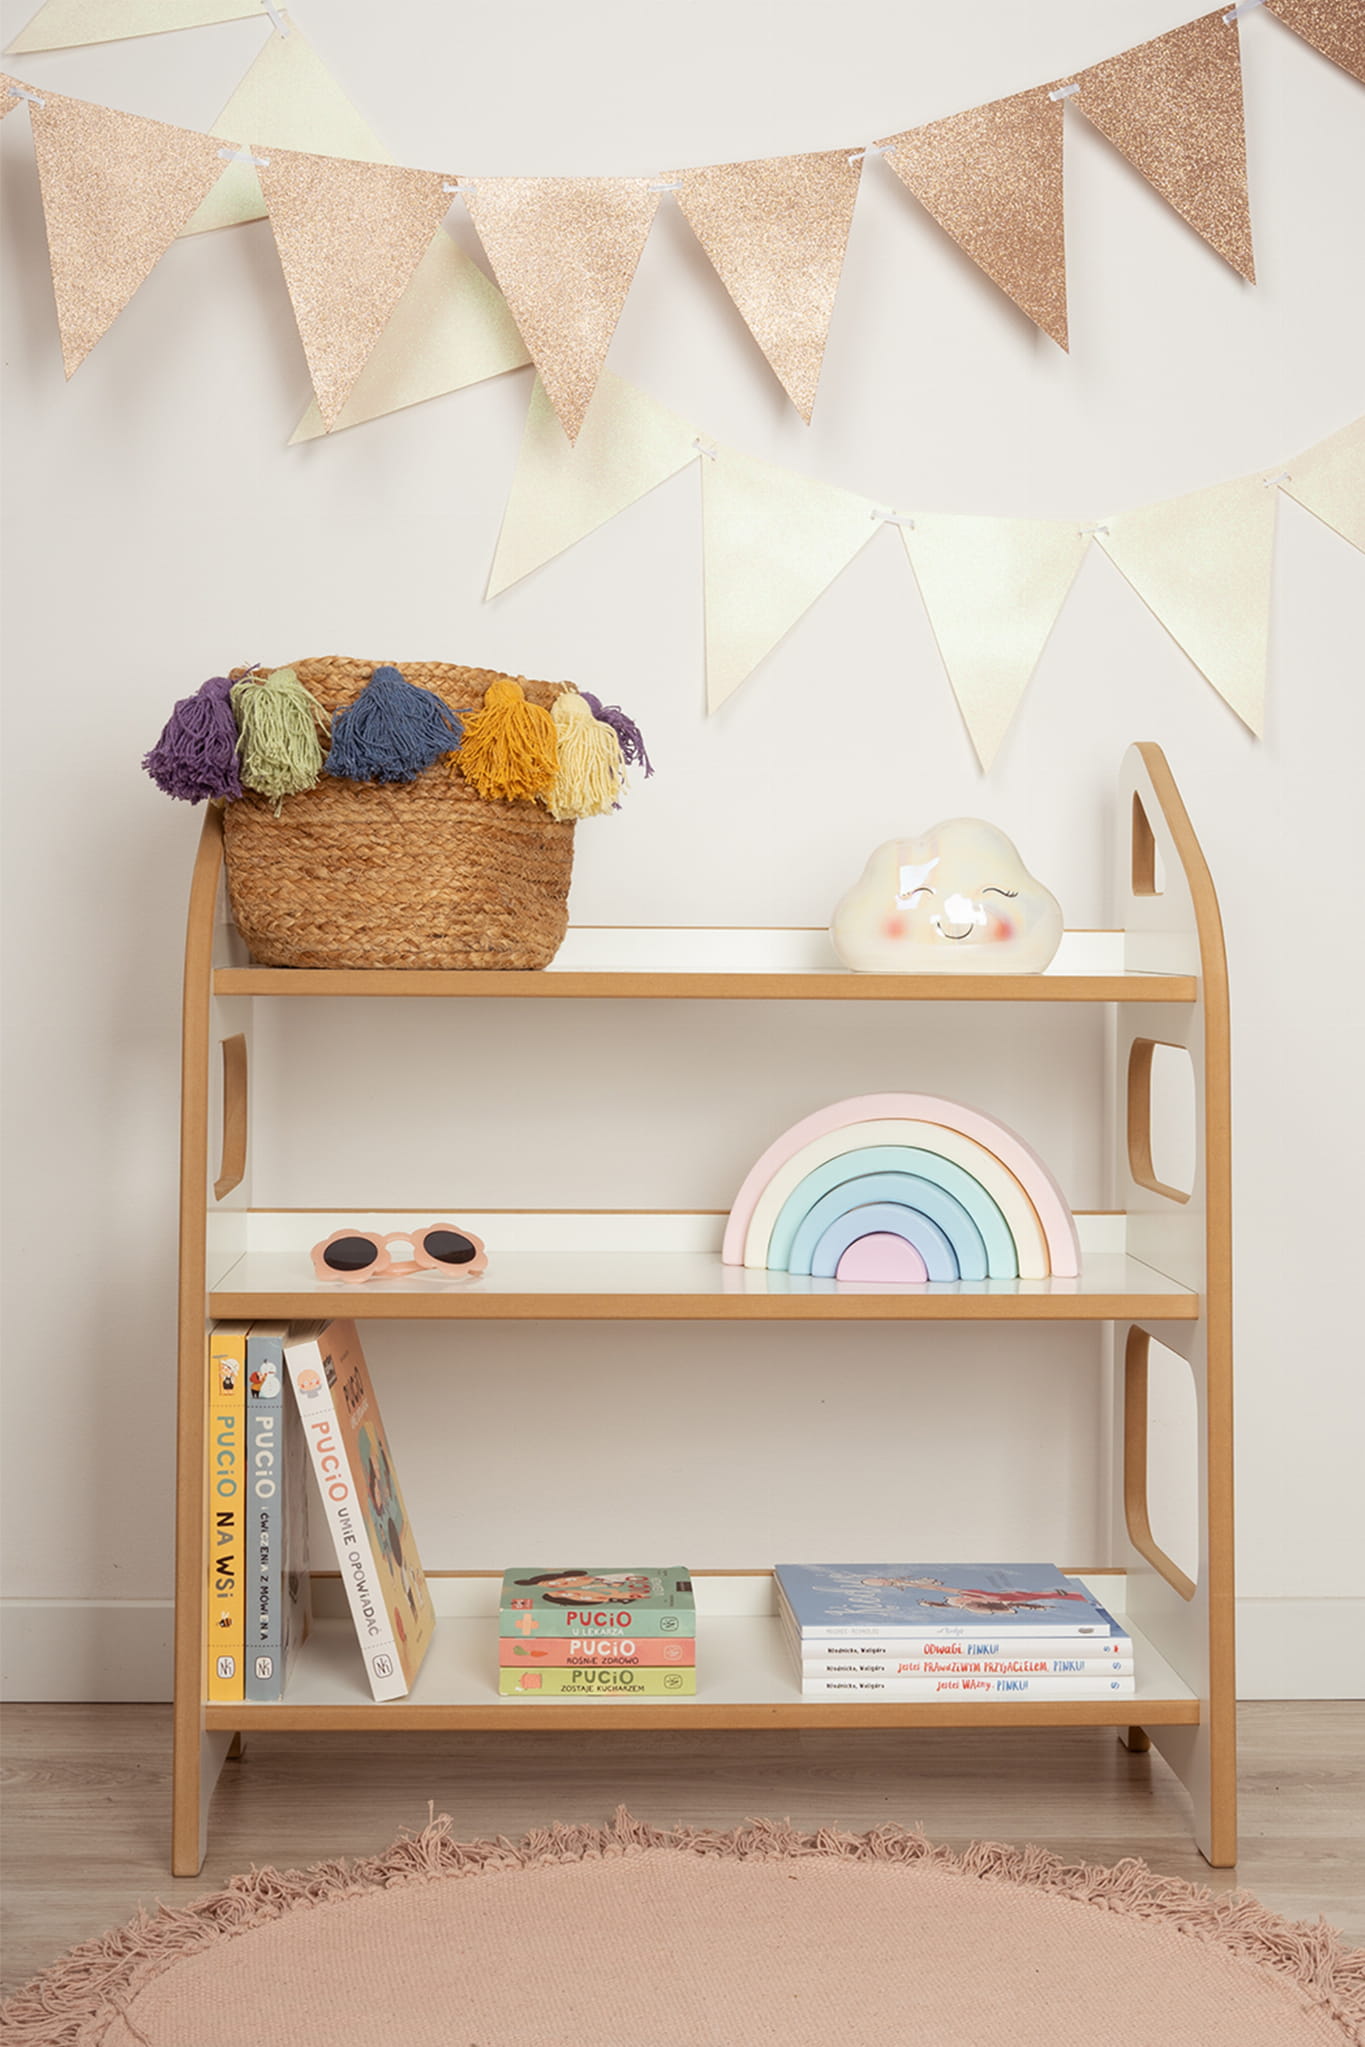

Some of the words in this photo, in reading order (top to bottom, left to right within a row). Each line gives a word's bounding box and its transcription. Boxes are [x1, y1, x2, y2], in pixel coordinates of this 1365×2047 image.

[217, 1416, 238, 1497] PUCiO
[255, 1416, 276, 1498] PUCiO
[311, 1421, 348, 1502] PUCiO
[216, 1511, 235, 1546] NA
[566, 1611, 632, 1628] PUCiO
[571, 1628, 580, 1636] U
[582, 1627, 624, 1636] LEKARZA
[569, 1640, 636, 1656] PUCiO
[602, 1657, 640, 1665] ZDROWO
[572, 1670, 634, 1684] PUCiO
[560, 1685, 594, 1693] ZOSTAJE
[597, 1684, 645, 1693] KUCHARZEM
